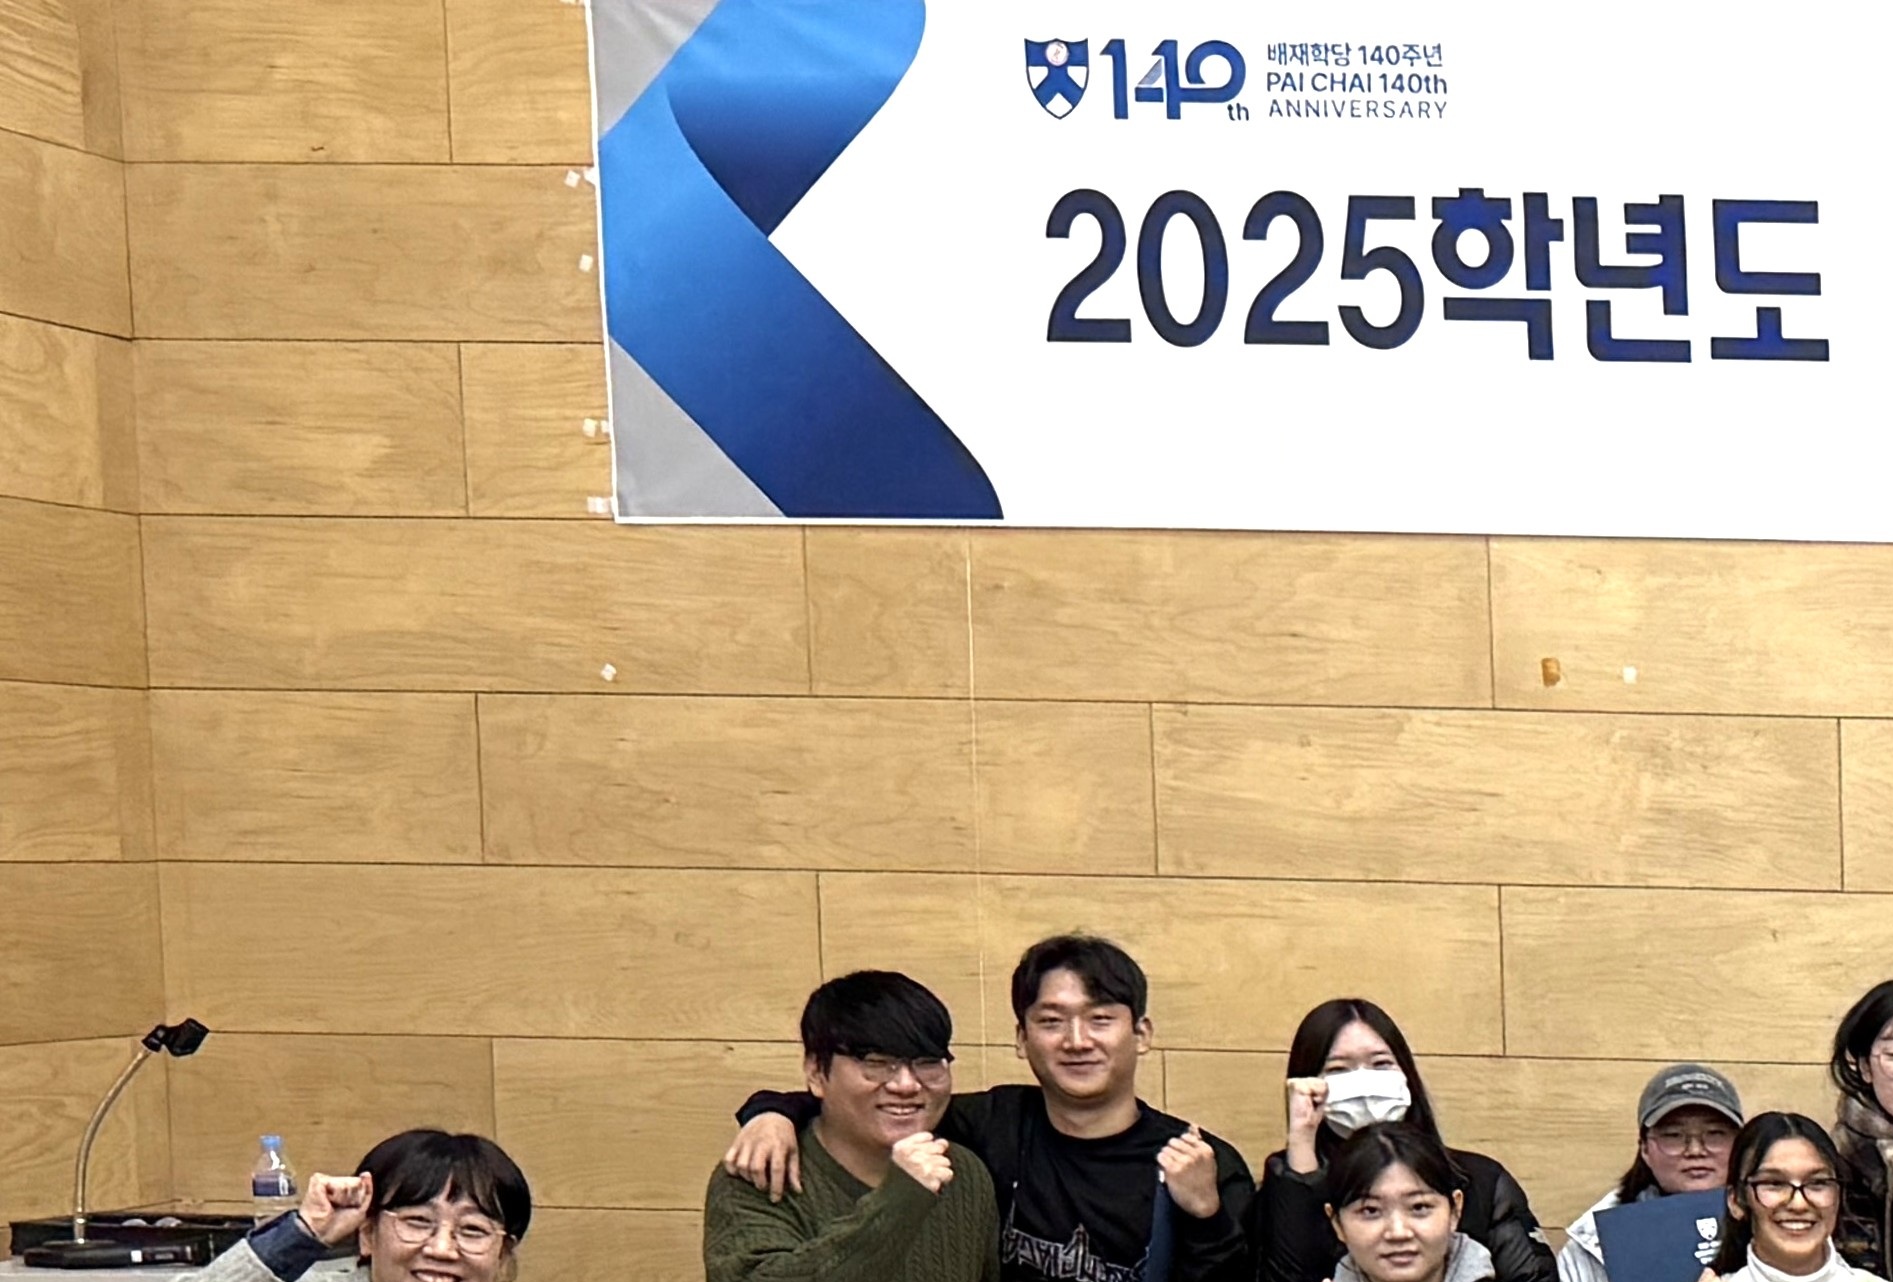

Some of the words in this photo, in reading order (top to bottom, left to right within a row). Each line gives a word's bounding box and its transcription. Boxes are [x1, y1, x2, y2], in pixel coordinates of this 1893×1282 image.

[1267, 43, 1352, 67] 배재학당
[1358, 44, 1443, 68] 140주년
[1267, 72, 1304, 93] PAI
[1310, 73, 1372, 93] CHAI
[1378, 73, 1448, 95] 140th
[1269, 99, 1447, 119] ANNIVERSARY
[1045, 187, 1830, 364] 2025학년도
